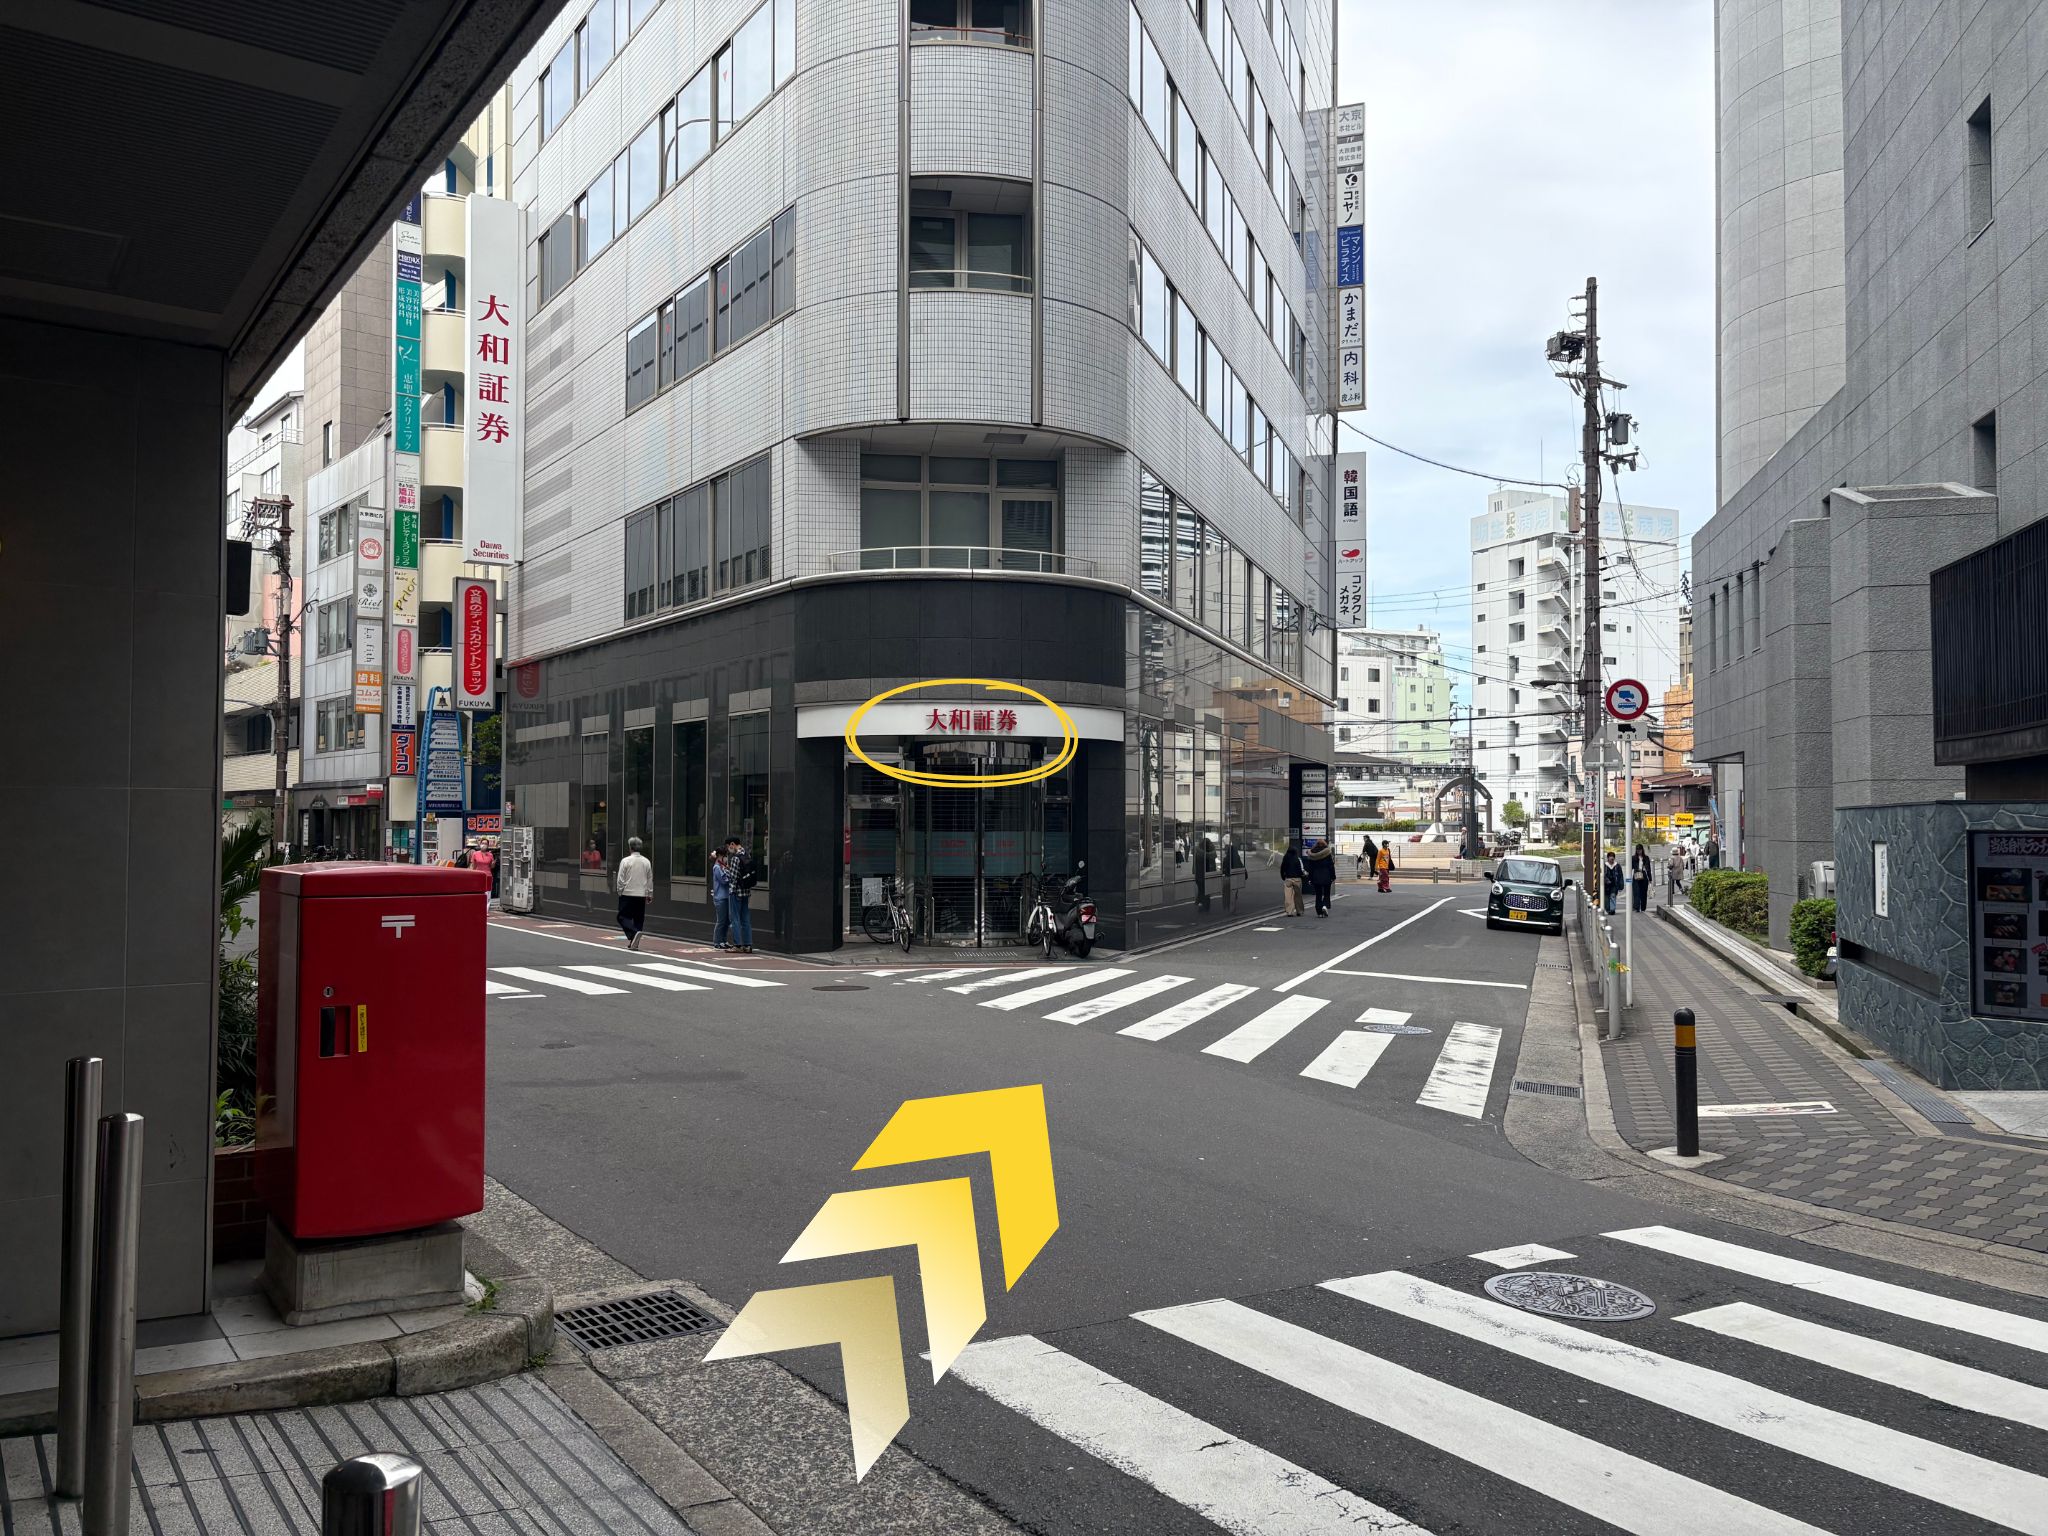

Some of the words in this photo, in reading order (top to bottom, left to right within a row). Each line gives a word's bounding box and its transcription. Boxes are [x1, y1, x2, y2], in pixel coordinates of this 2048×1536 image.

[1339, 110, 1362, 123] 大京
[1343, 191, 1354, 223] コヤノ
[1340, 236, 1351, 283] ピラティス
[1351, 236, 1361, 264] マシン
[1344, 293, 1359, 337] かまだ
[477, 294, 509, 443] 大和証券
[1343, 470, 1358, 517] 韓国語
[473, 549, 509, 560] Securities
[480, 540, 502, 550] Daiwa
[1340, 585, 1350, 615] メガネ
[1352, 575, 1362, 625] コンタクト
[469, 589, 483, 692] 文具のディスカウントショップ
[358, 673, 380, 684] 歯科
[459, 700, 491, 708] FUKUYA
[926, 709, 1018, 731] 大和証券
[396, 734, 409, 773] ダイコク
[478, 817, 500, 829] ダイコク
